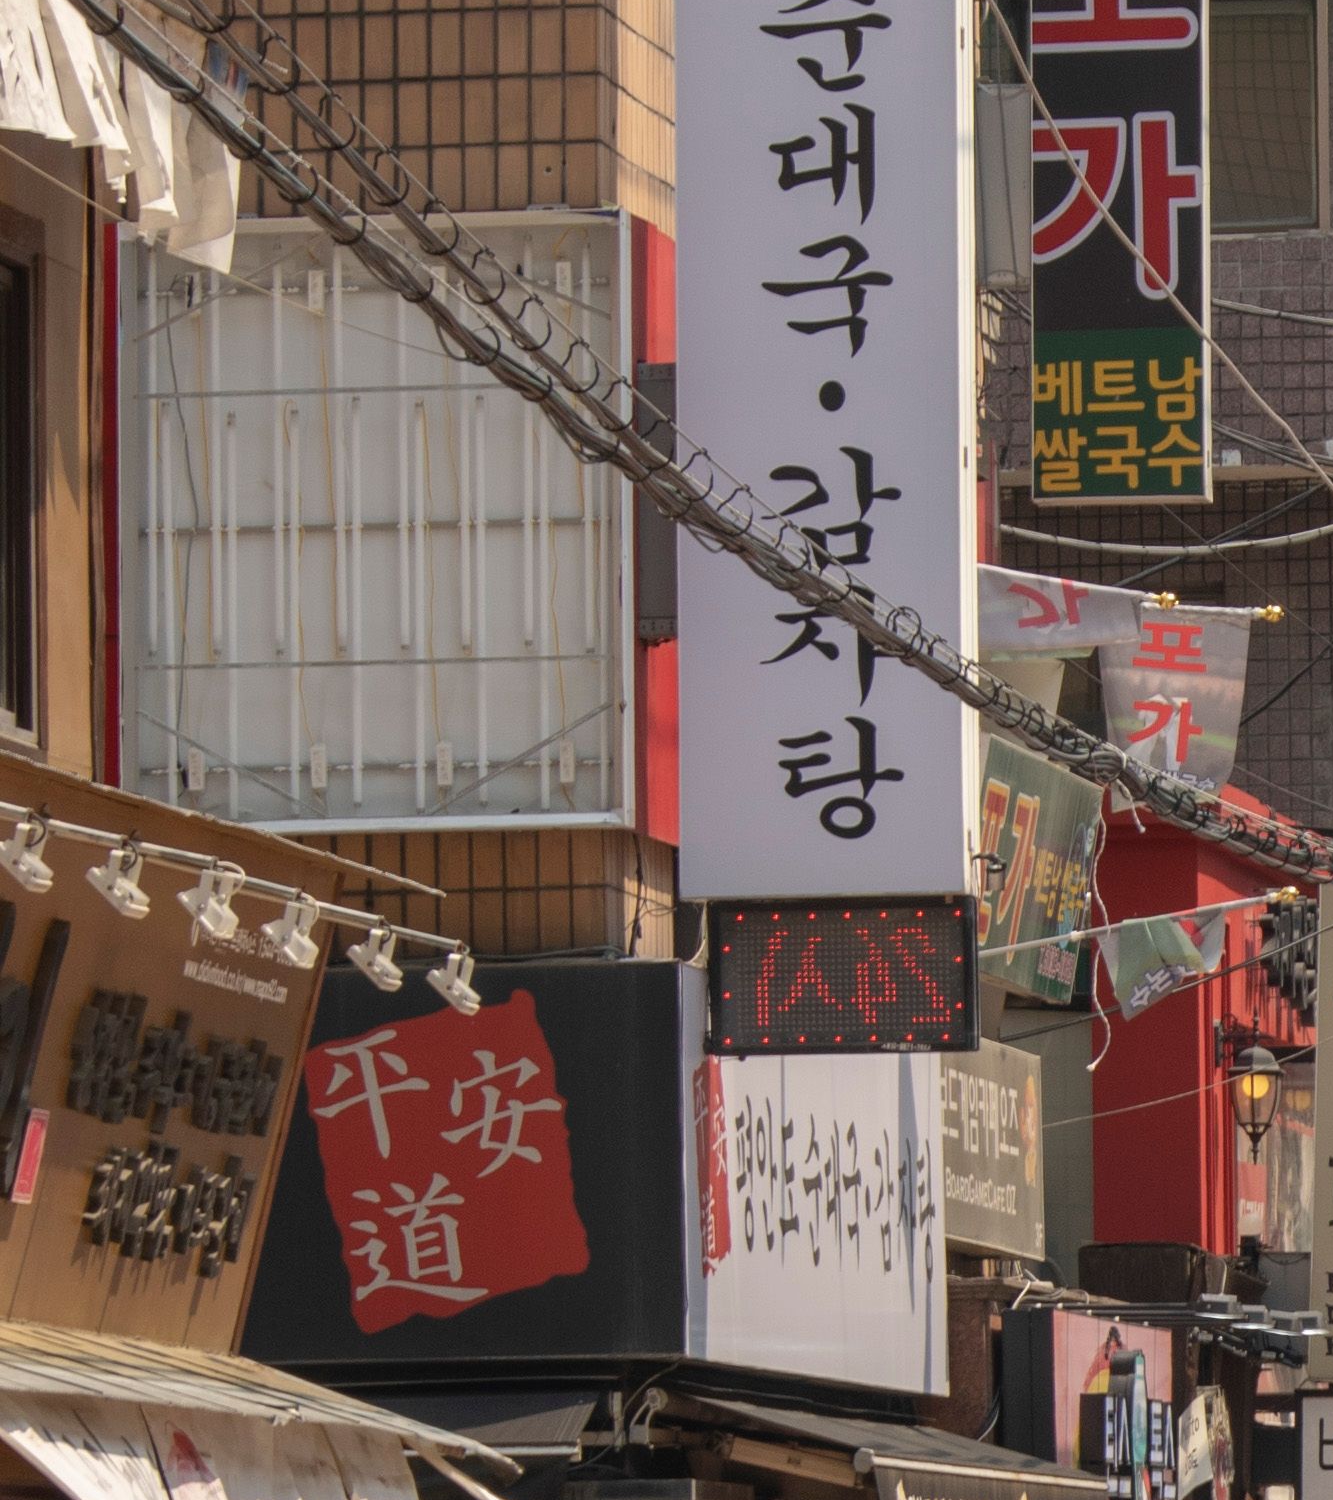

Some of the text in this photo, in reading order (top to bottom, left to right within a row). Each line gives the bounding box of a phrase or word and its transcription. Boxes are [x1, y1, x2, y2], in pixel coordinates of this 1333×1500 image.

[1032, 357, 1203, 423] 베트남
[1032, 424, 1204, 493] 쌀국수
[1128, 620, 1208, 764] 포가
[733, 1092, 800, 1254] 평안도
